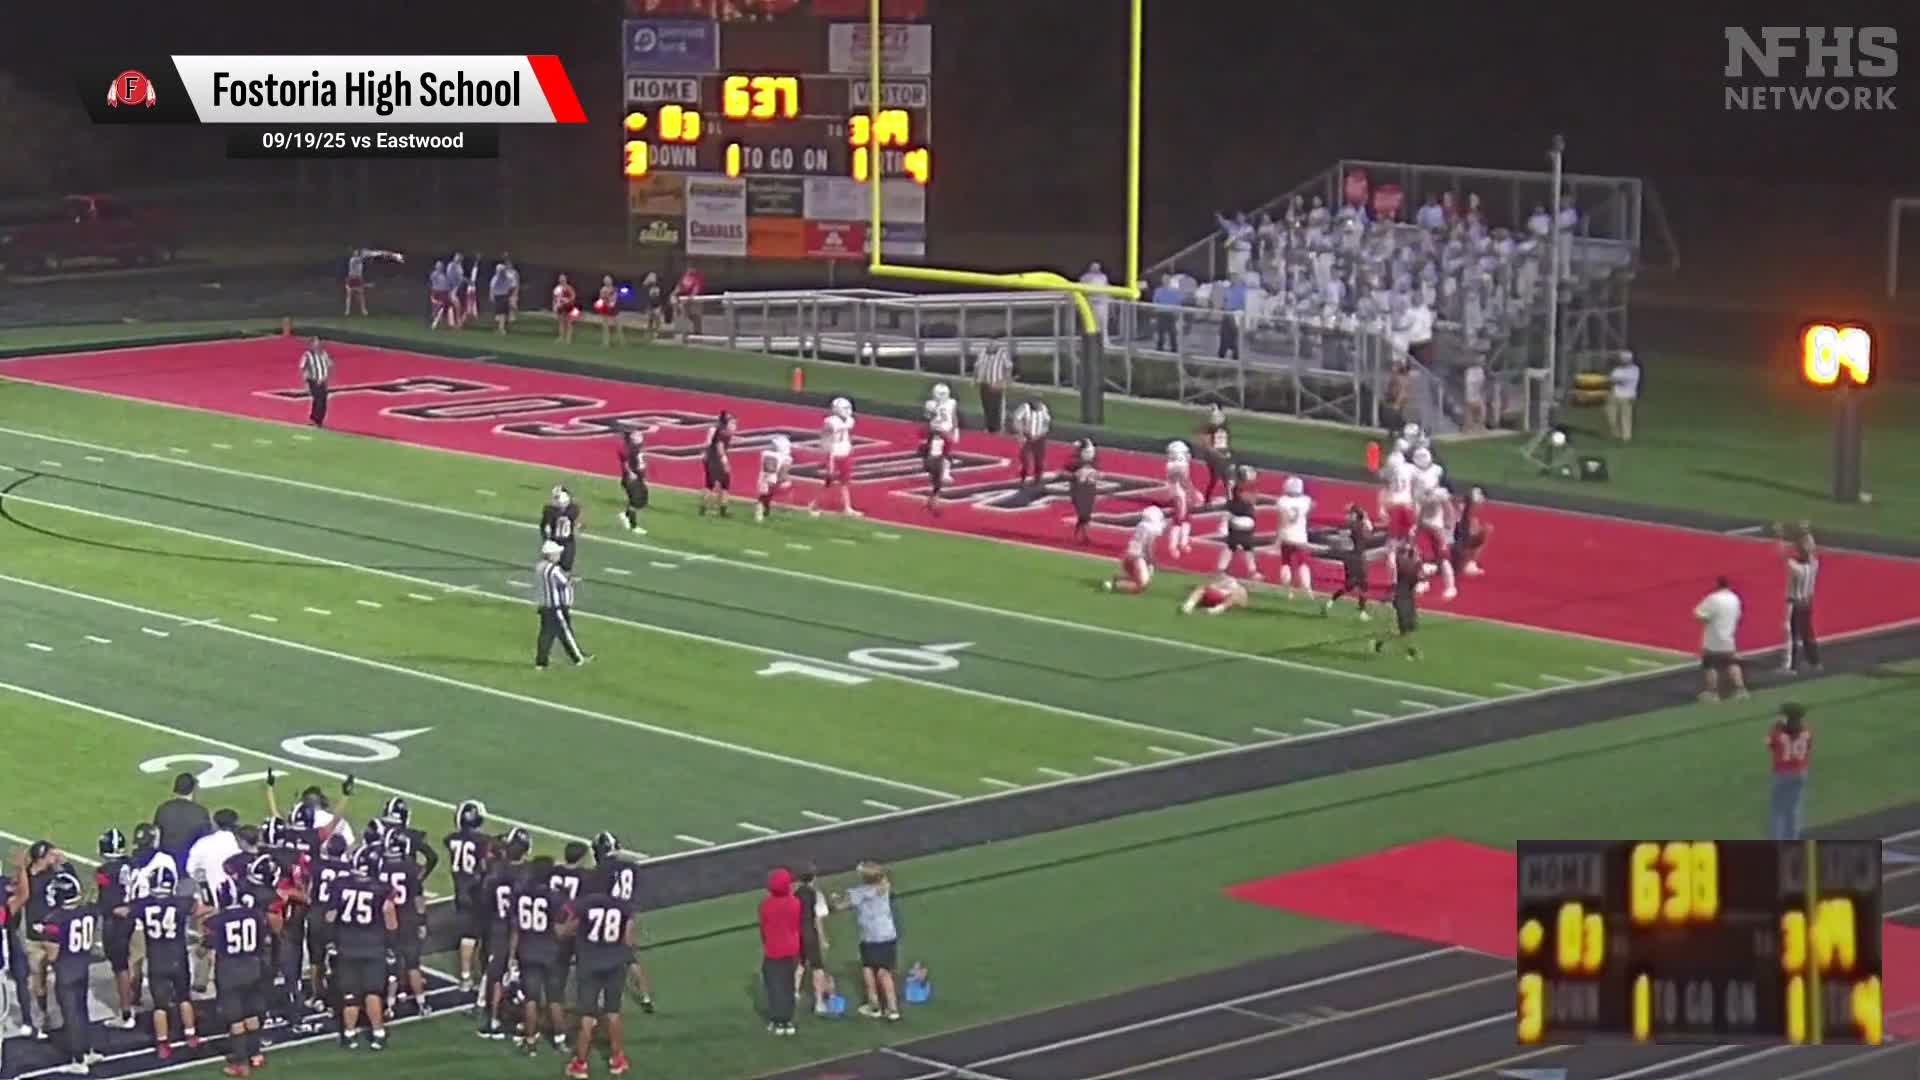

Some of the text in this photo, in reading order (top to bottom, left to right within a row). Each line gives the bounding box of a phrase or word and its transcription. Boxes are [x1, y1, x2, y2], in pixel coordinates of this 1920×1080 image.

[633, 81, 693, 99] HOME
[624, 140, 648, 175] 3
[743, 147, 828, 170] TO GO ON
[138, 734, 401, 788] 20
[450, 840, 476, 874] 76
[145, 906, 177, 938] 54
[341, 889, 374, 924] 75
[518, 895, 548, 932] 66
[68, 915, 94, 953] 60
[225, 917, 257, 954] 50
[588, 907, 622, 942] 78
